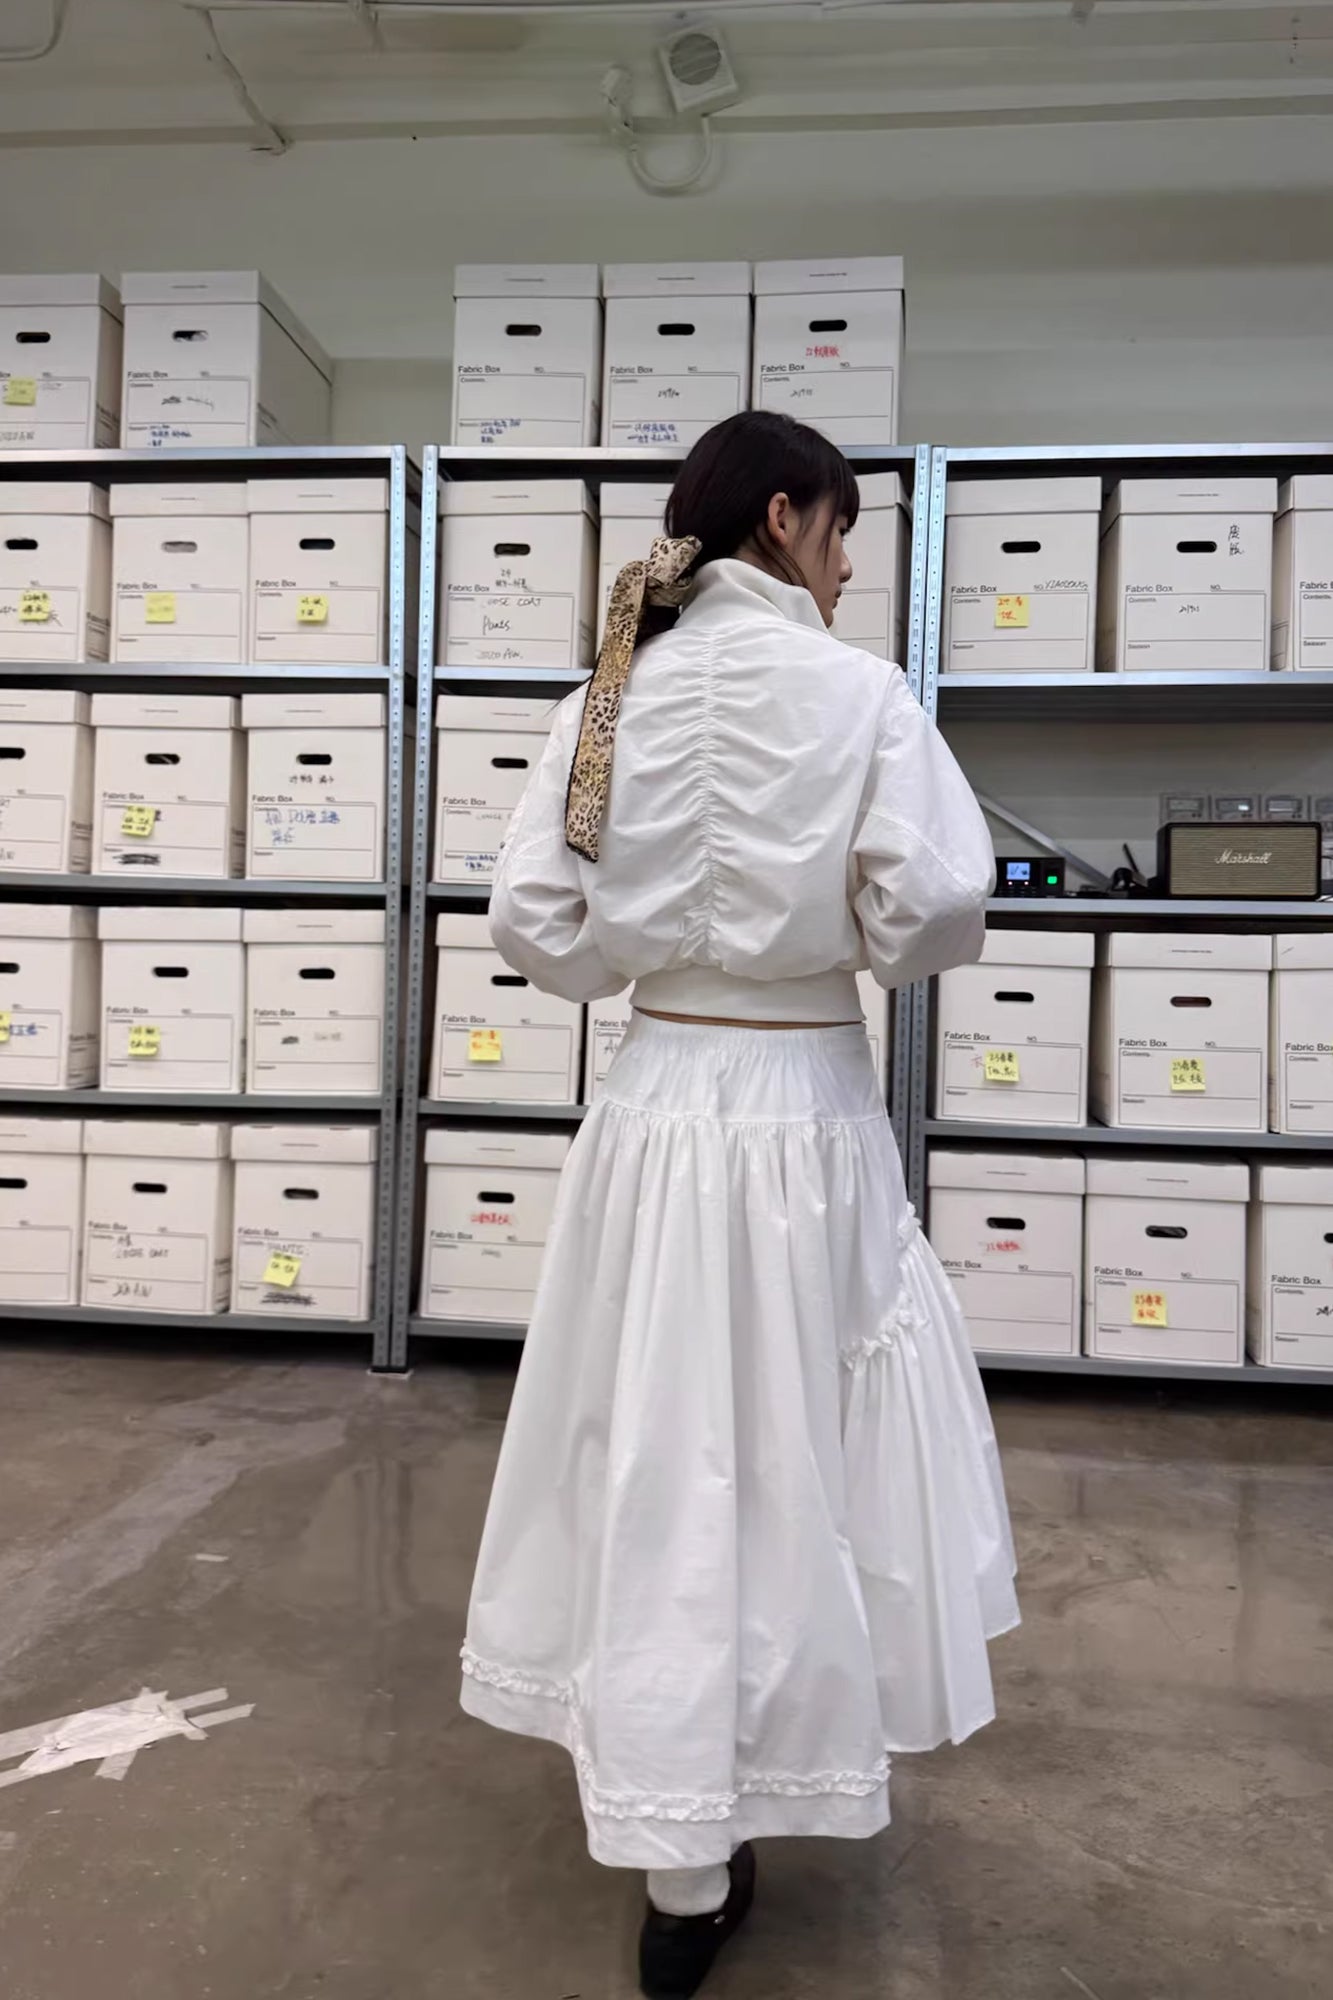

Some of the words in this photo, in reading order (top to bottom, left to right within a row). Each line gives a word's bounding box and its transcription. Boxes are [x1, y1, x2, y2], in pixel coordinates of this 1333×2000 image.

[485, 365, 501, 373] Box
[610, 366, 635, 374] Fabric
[761, 364, 787, 372] Fabric
[789, 363, 805, 371] Box
[448, 584, 473, 592] Fabric
[474, 584, 490, 592] Box
[951, 586, 978, 594] Fabric
[980, 585, 997, 593] Box
[1125, 585, 1153, 593] Fabric
[1300, 581, 1328, 590] Fabric
[443, 797, 468, 805] Fabric
[1215, 850, 1272, 864] Marshall
[442, 1014, 468, 1023] Fabric
[470, 1015, 486, 1023] Box
[594, 1019, 619, 1028] Fabric
[944, 1031, 971, 1040] Fabric
[973, 1032, 991, 1041] Box
[1119, 1038, 1148, 1047] Fabric
[1149, 1039, 1167, 1047] Box
[1285, 1043, 1315, 1051] Fabric
[964, 1260, 982, 1269] Box
[1094, 1266, 1122, 1276] Fabric
[1125, 1268, 1143, 1277] Box
[1271, 1275, 1300, 1284] Fabric
[1303, 1276, 1321, 1285] Box
